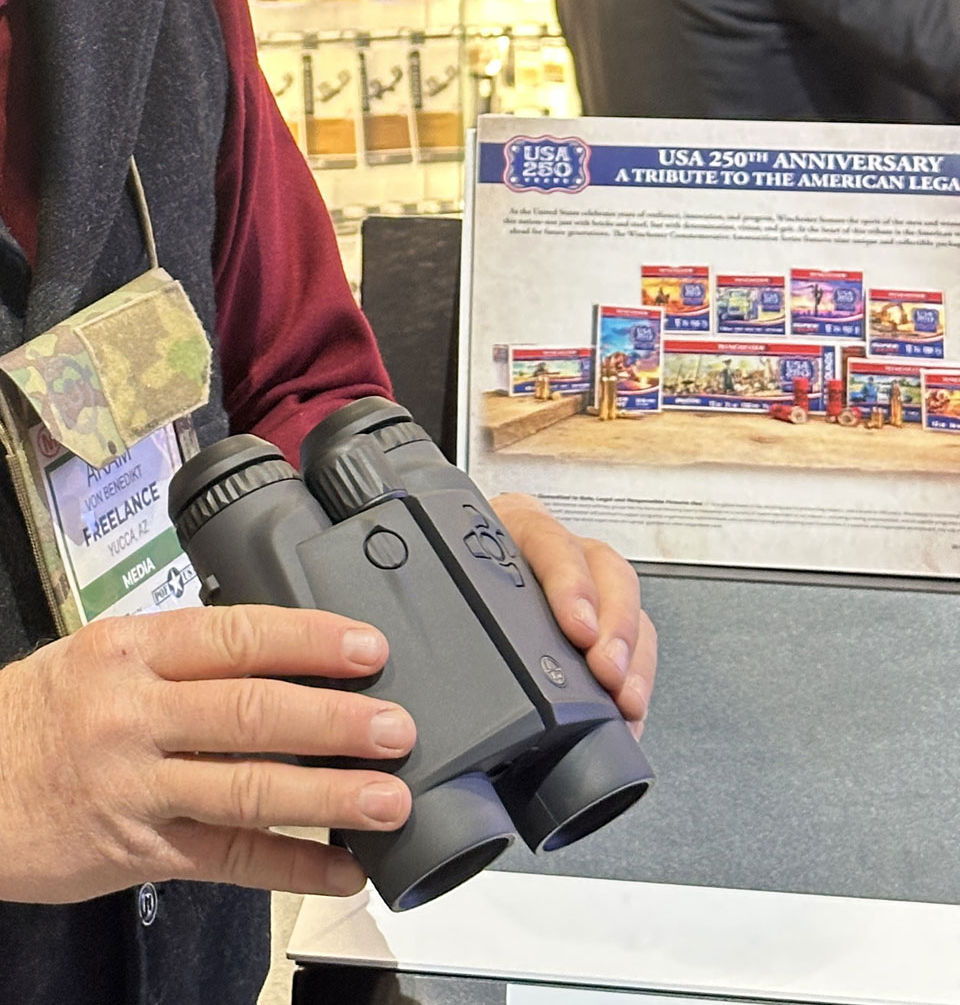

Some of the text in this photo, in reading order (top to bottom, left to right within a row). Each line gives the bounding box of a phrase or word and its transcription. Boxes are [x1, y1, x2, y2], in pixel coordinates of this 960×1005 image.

[523, 145, 571, 162] USA
[658, 149, 705, 166] USA
[772, 152, 945, 173] ANNIVERSARY
[522, 162, 572, 178] 250
[615, 168, 960, 192] A TRIBUTE TO THE AMERICAN LEGA
[84, 463, 144, 512] VON BENEDIKT
[82, 481, 161, 547] FREELANCE
[122, 557, 156, 590] MEDIA
